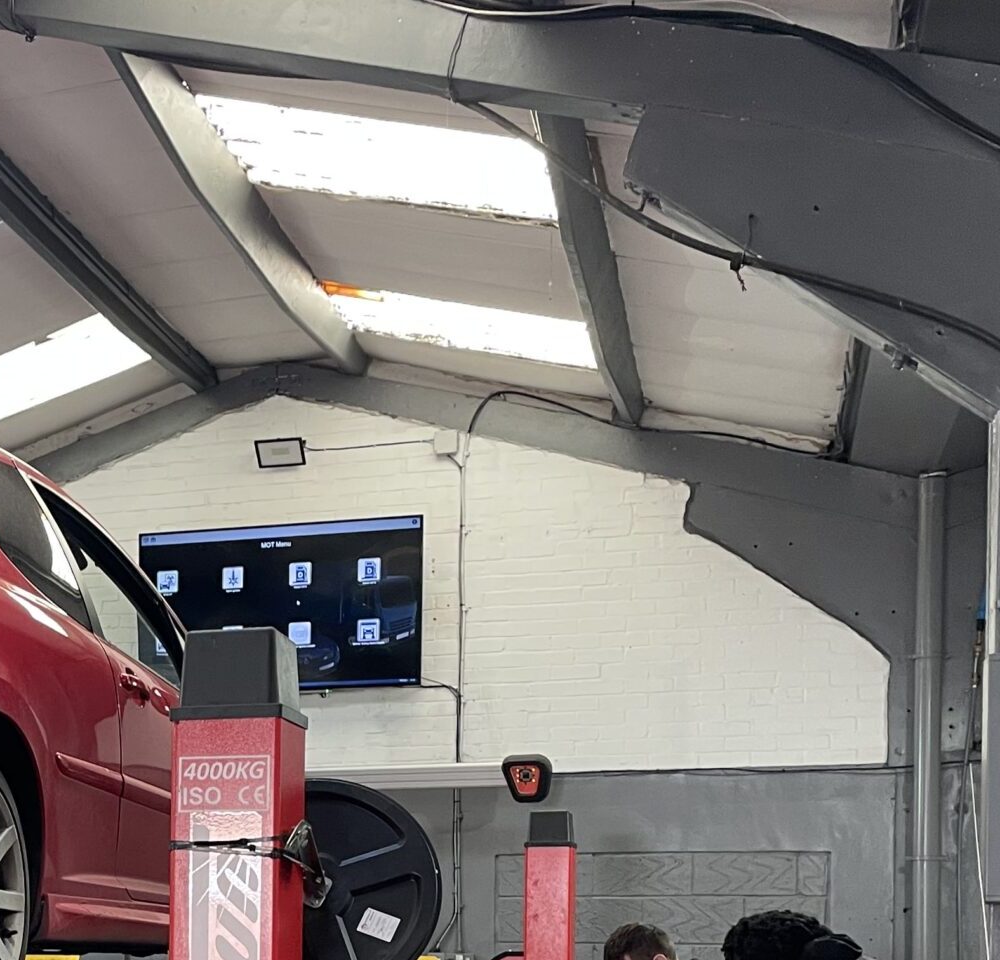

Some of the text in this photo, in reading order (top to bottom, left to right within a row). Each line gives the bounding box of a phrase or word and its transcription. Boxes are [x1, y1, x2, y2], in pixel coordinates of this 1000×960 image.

[183, 761, 267, 780] 4000KG
[182, 785, 267, 806] ISO CE
